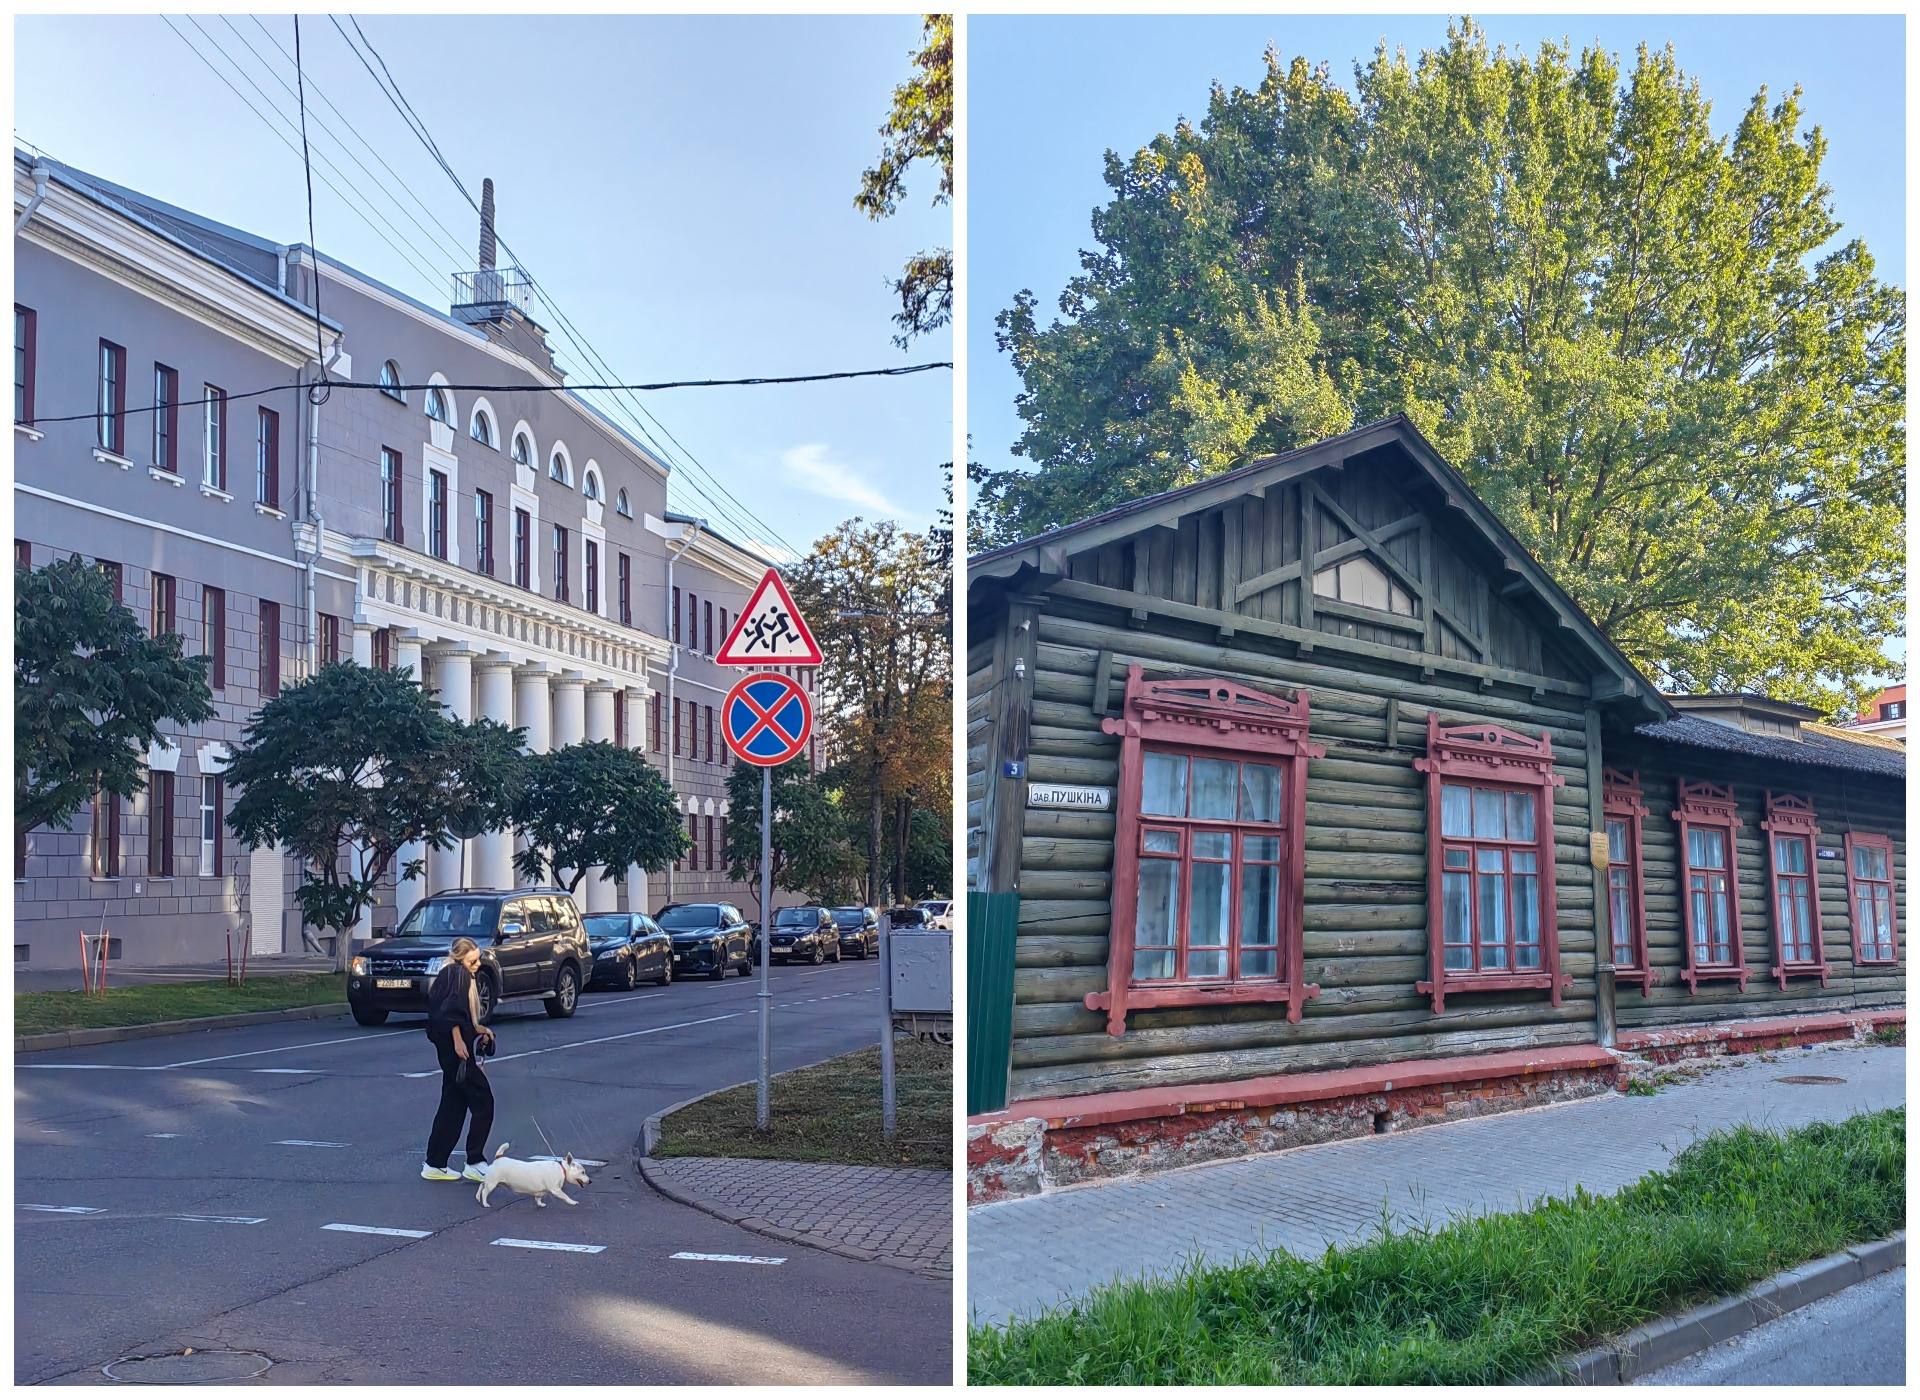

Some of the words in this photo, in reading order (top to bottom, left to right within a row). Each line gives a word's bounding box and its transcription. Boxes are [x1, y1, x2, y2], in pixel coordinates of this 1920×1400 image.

[1010, 763, 1018, 775] 3
[1033, 792, 1050, 803] ЗАВ.
[1051, 790, 1102, 804] ПУШКІНА
